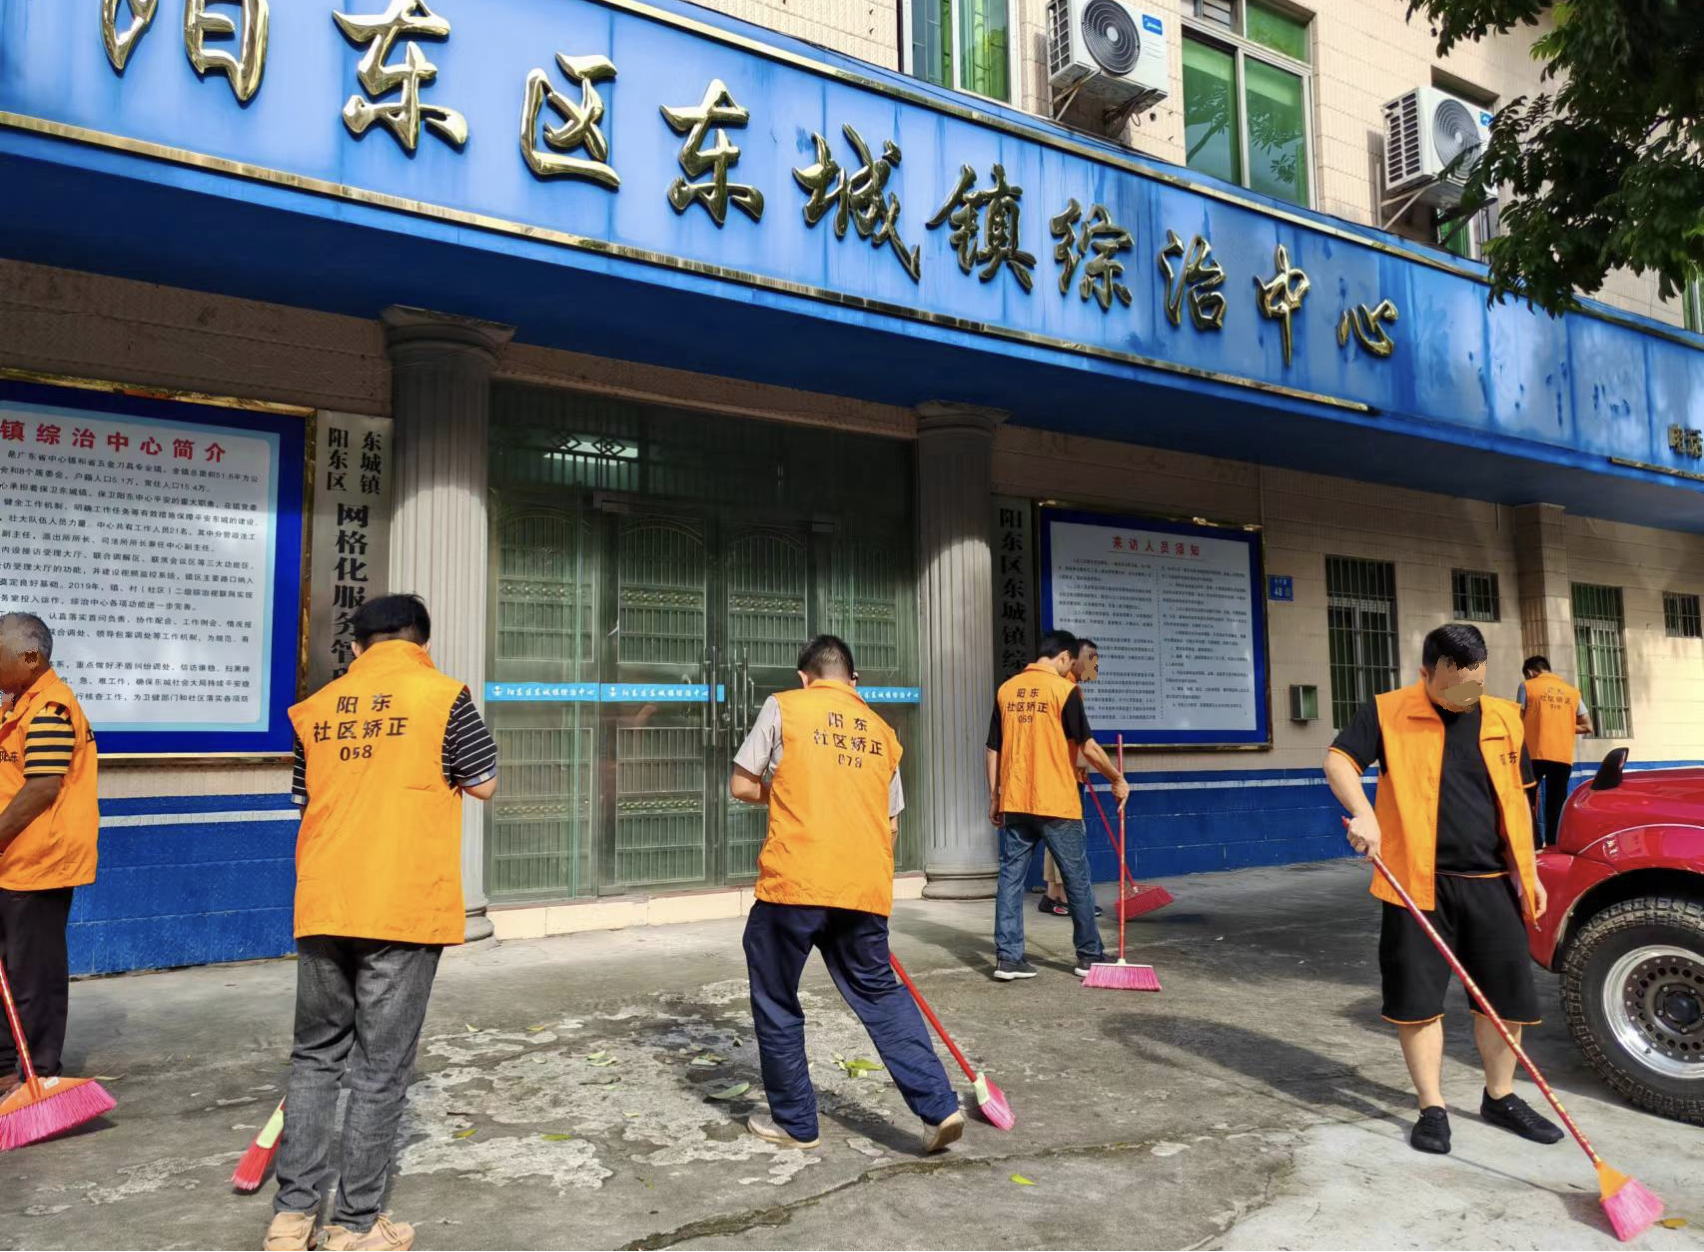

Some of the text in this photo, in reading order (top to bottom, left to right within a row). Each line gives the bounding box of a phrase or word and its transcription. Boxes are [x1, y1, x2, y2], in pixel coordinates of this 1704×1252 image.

[0, 419, 226, 463] 镇综治中心简介
[326, 427, 349, 491] 阳东区
[360, 431, 382, 495] 东城镇
[336, 693, 393, 714] 阳东
[1017, 688, 1039, 698] 阳东
[1007, 701, 1048, 713] 社区矫正
[314, 717, 408, 742] 社区矫正
[829, 712, 867, 732] 阳东
[340, 745, 373, 761] 058
[814, 728, 883, 757] 社区矫正
